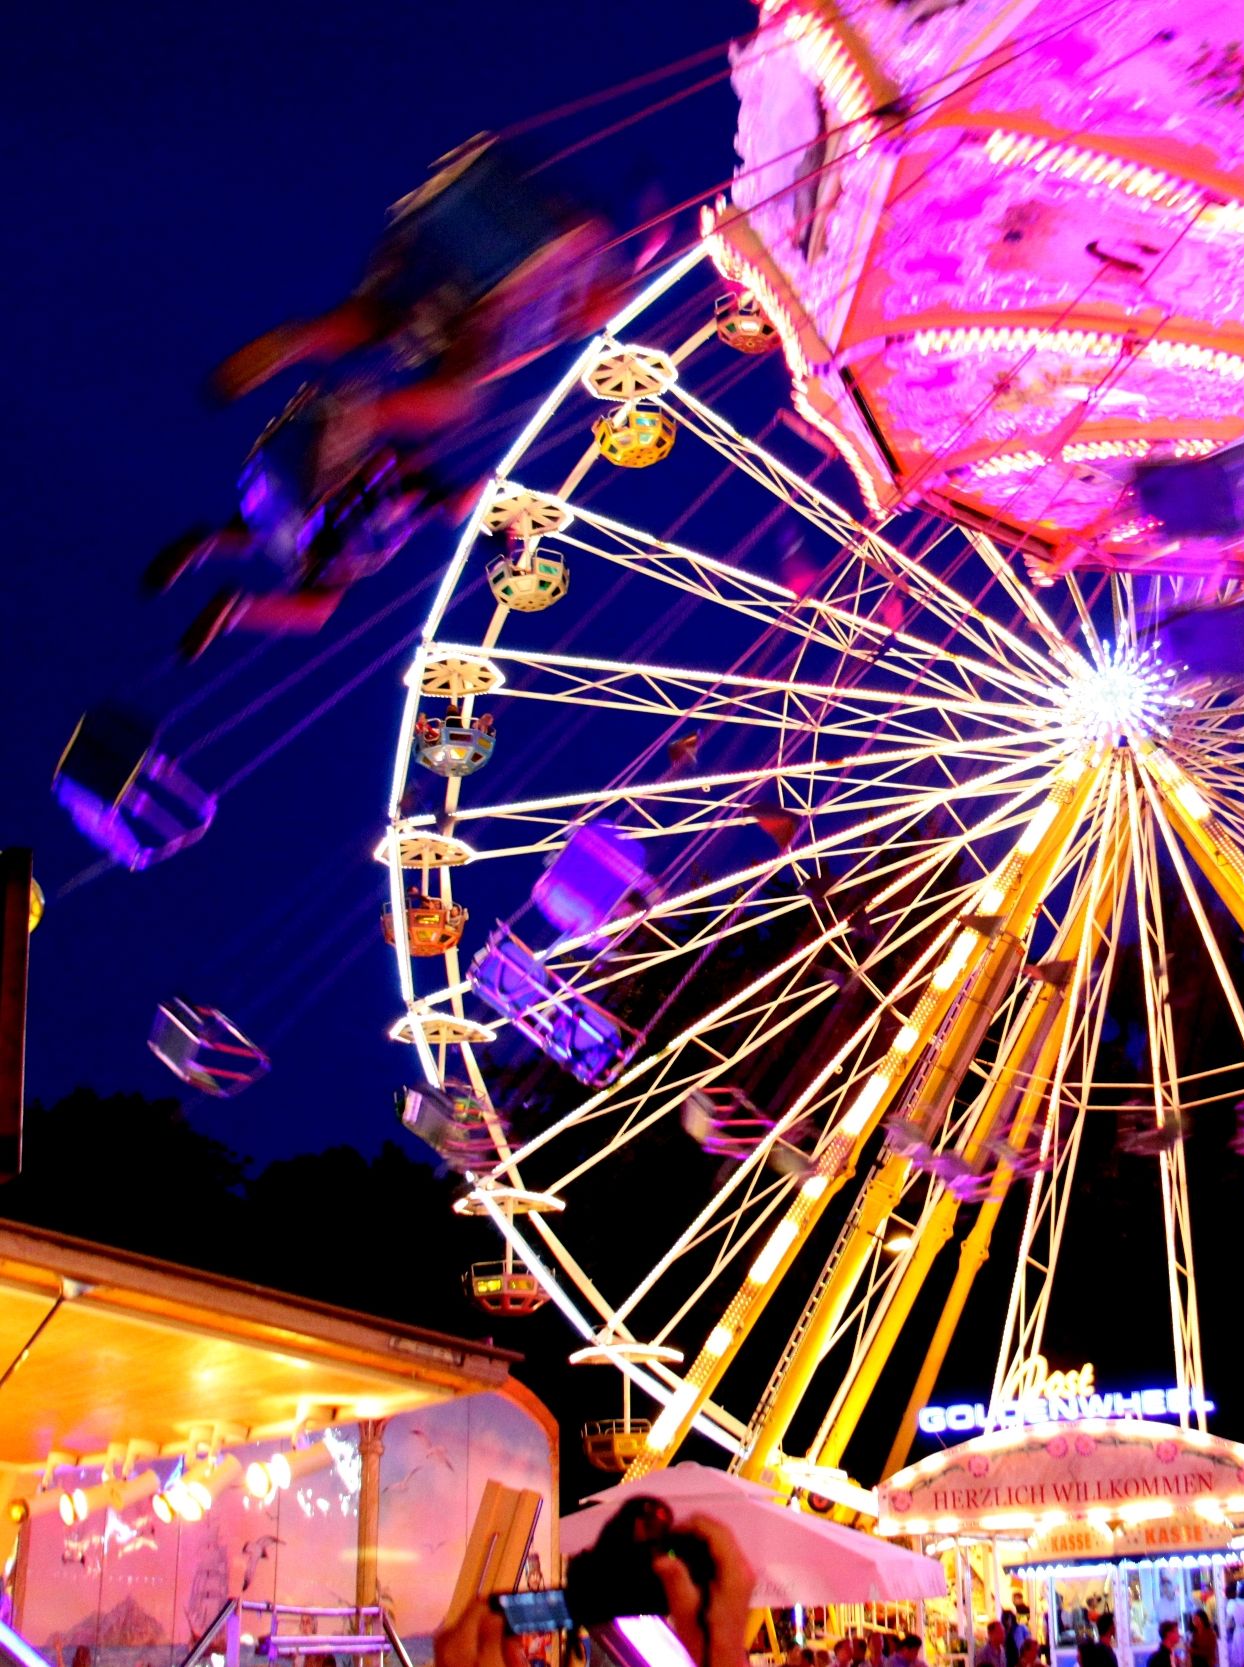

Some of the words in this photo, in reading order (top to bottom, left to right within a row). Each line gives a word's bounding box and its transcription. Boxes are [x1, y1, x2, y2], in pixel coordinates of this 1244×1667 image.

[934, 1485, 1046, 1511] HERZLICH
[1053, 1472, 1214, 1504] WILLKOMMEN
[1051, 1533, 1092, 1552] KASSE
[1144, 1525, 1204, 1545] KASSE
